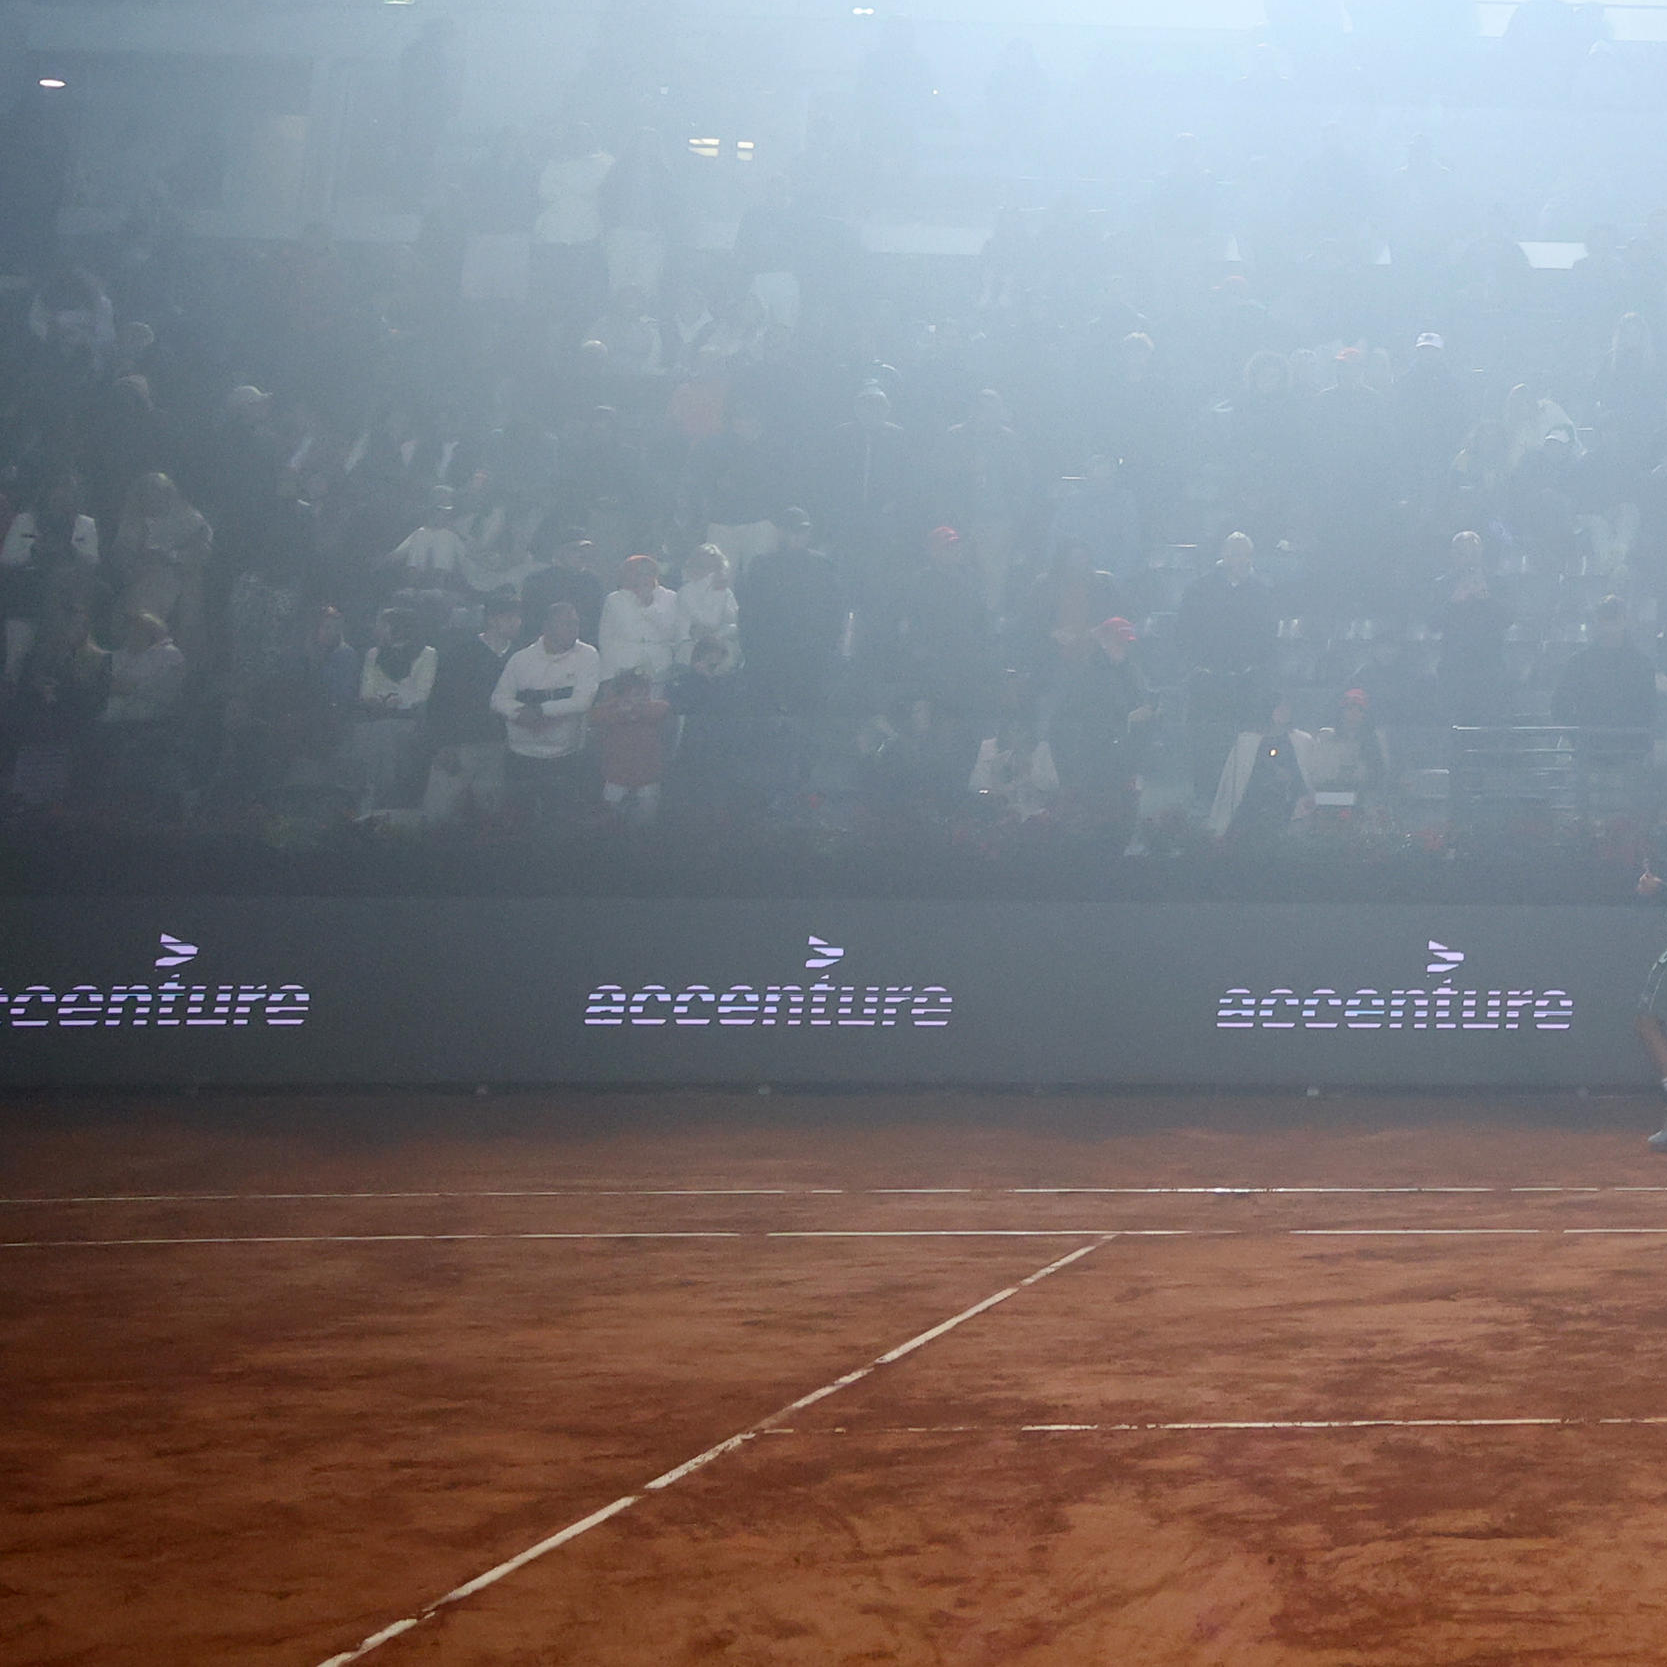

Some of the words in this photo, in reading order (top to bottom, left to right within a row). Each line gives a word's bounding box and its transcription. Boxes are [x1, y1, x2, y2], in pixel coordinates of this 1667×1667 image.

[0, 974, 310, 1026] centure
[584, 975, 953, 1026] accenture
[1216, 978, 1573, 1028] accenture
